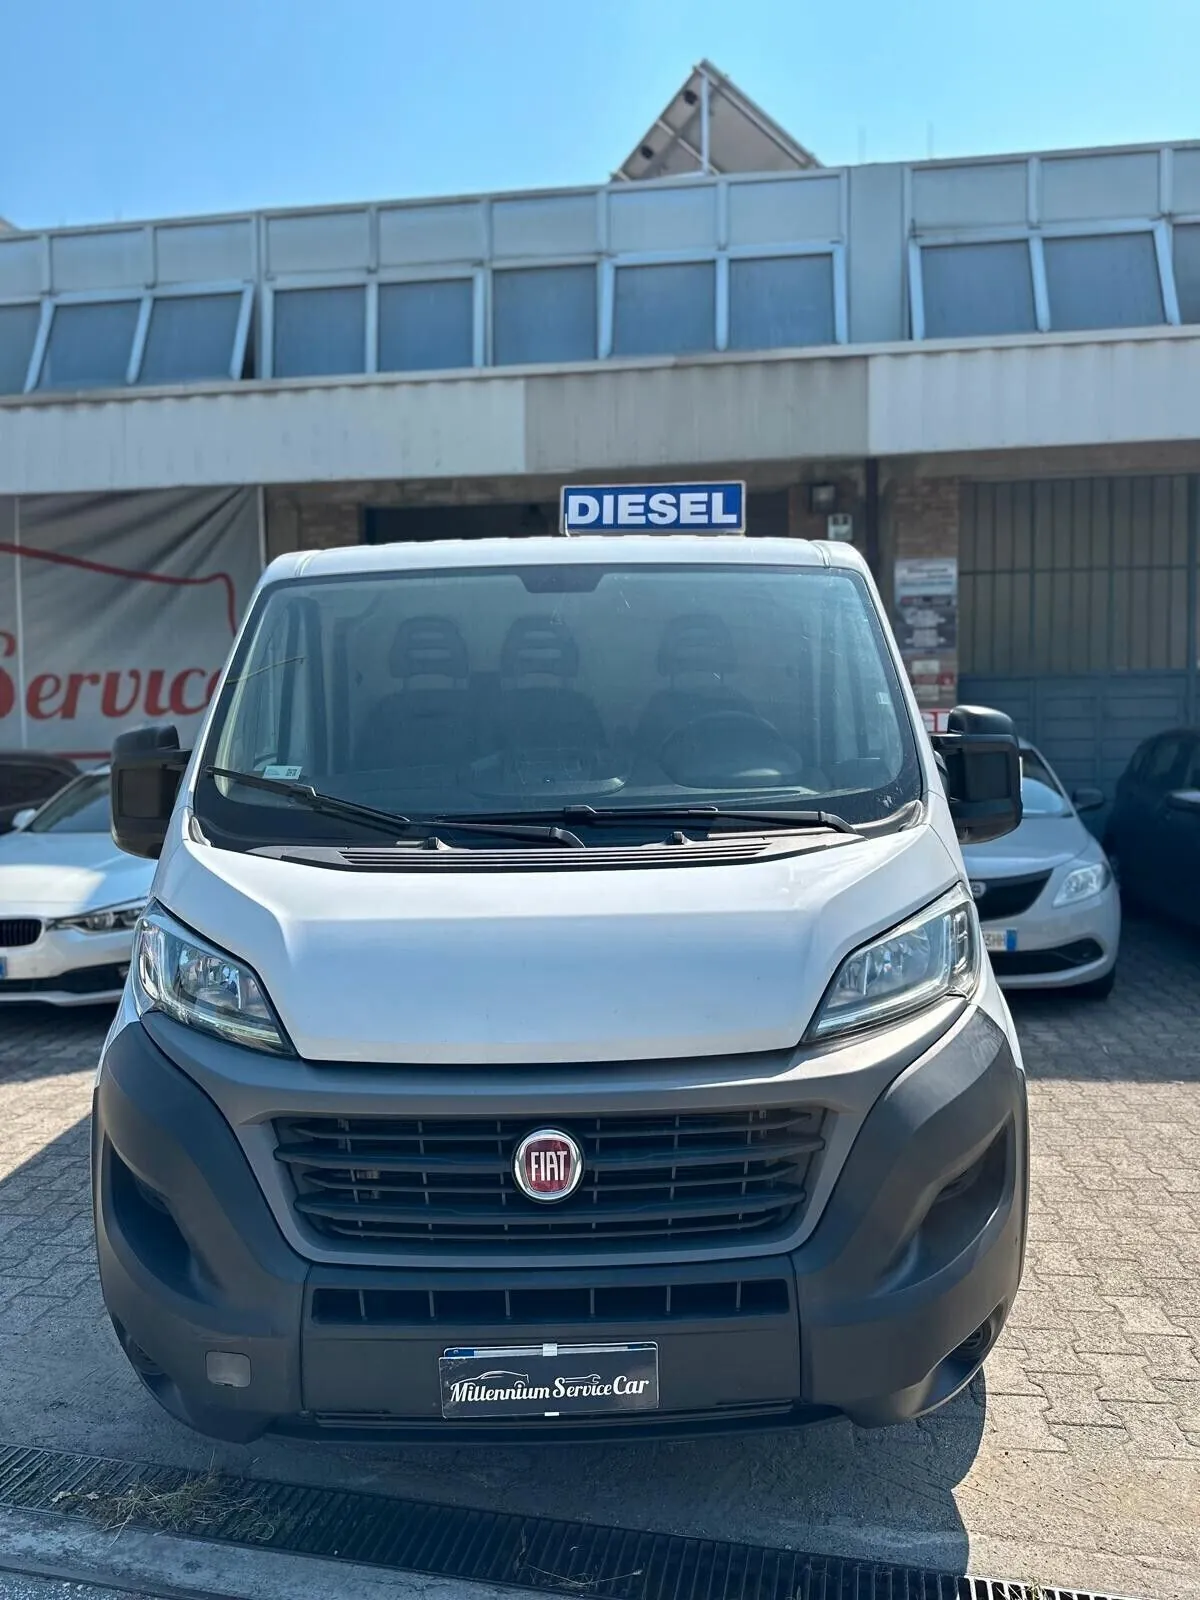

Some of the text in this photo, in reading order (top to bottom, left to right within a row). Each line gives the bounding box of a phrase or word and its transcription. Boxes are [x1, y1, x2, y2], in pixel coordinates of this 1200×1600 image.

[567, 493, 738, 525] DIESEL
[530, 1150, 568, 1181] FIAT
[450, 1382, 550, 1402] Millennium
